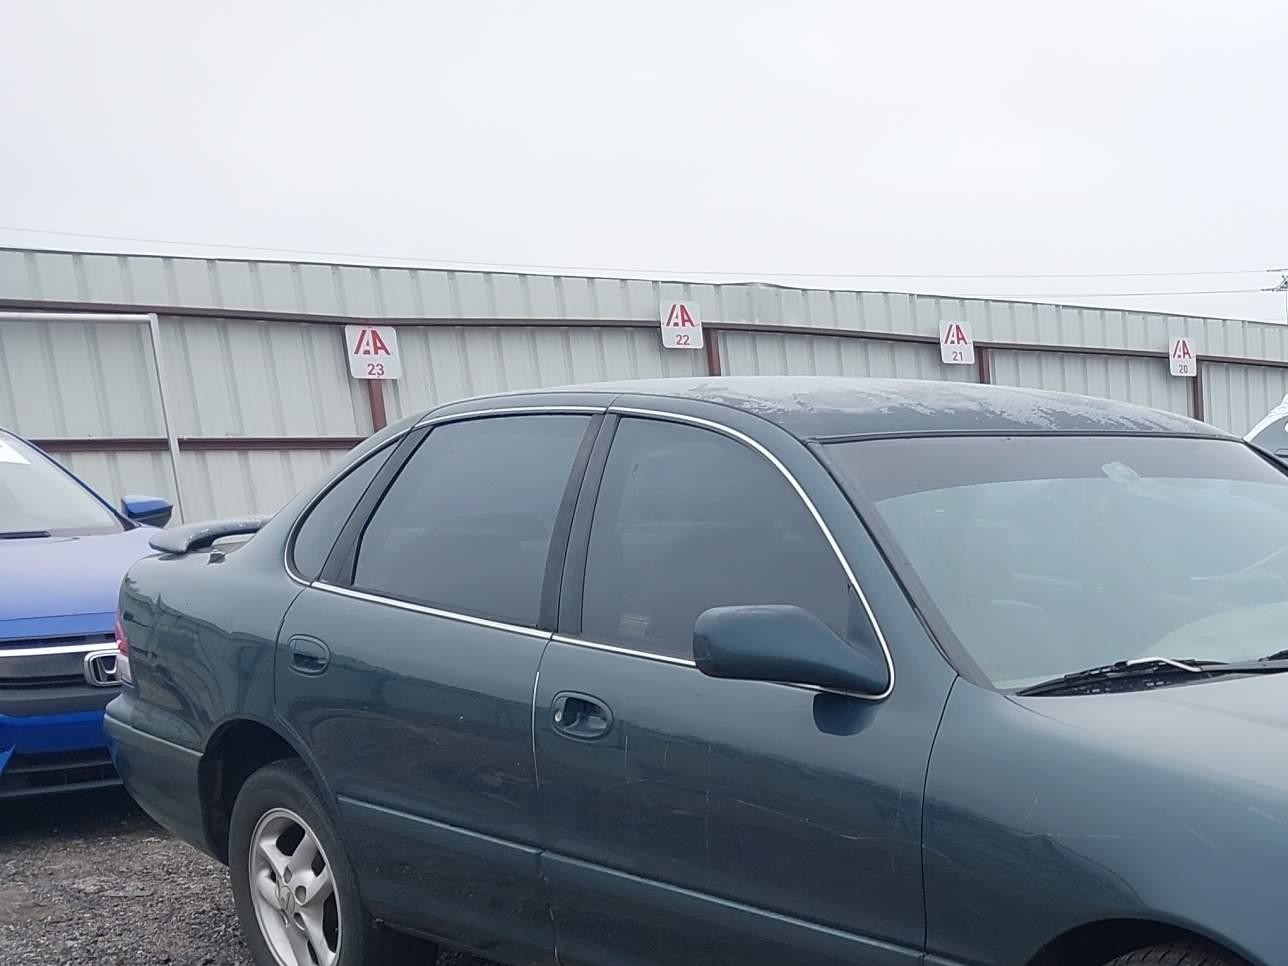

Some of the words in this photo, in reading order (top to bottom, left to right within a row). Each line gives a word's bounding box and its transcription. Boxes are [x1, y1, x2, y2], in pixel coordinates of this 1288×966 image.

[675, 334, 690, 345] 22
[952, 351, 963, 361] 21
[367, 363, 385, 376] 23
[1179, 365, 1188, 374] 20
